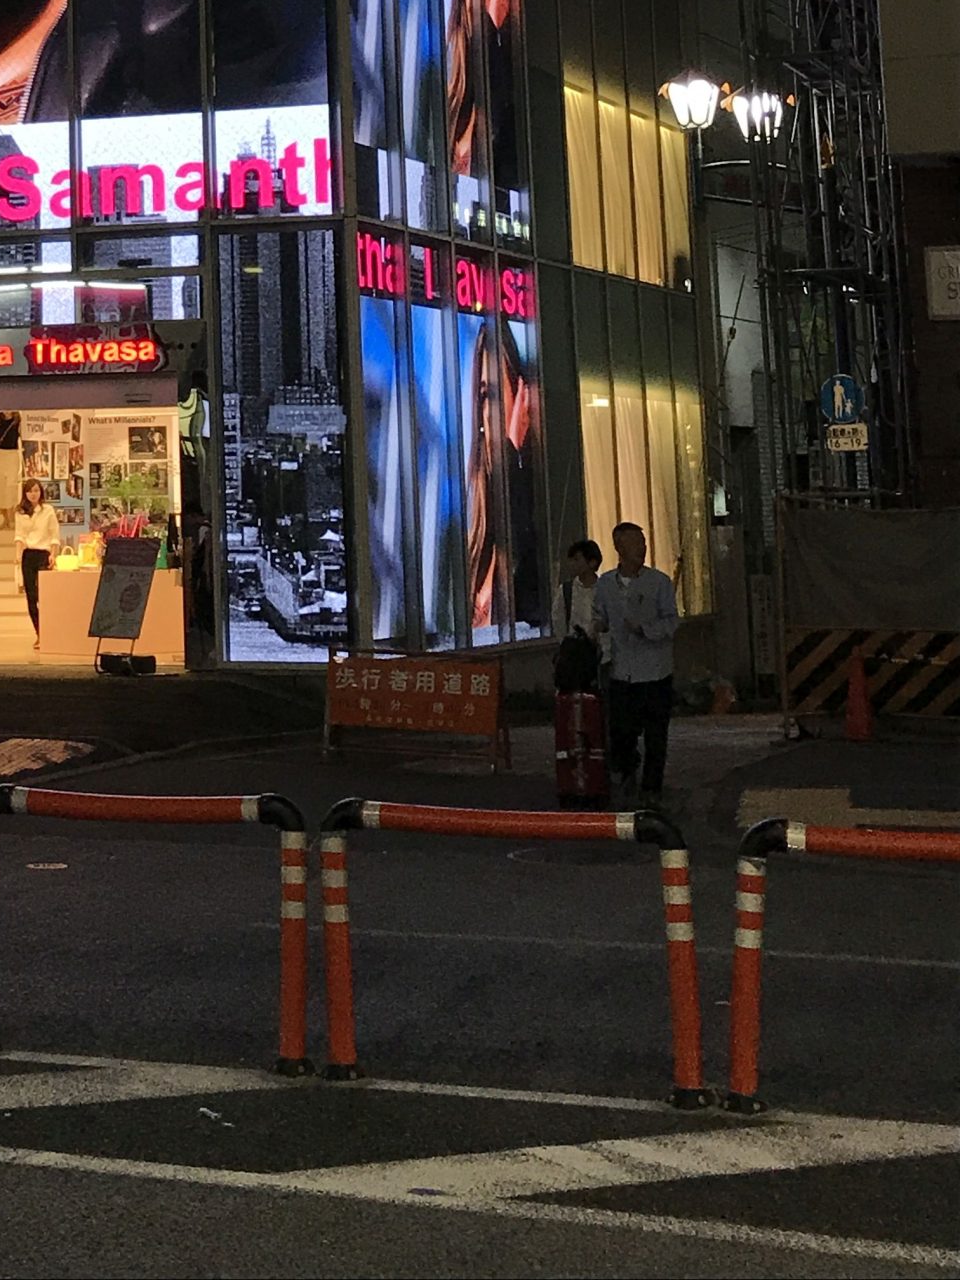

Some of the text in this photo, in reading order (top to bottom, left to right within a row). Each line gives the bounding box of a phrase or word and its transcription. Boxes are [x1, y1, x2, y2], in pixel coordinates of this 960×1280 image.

[30, 338, 156, 365] Thavasa
[88, 417, 112, 425] What's
[335, 667, 491, 697] 歩行者用道路
